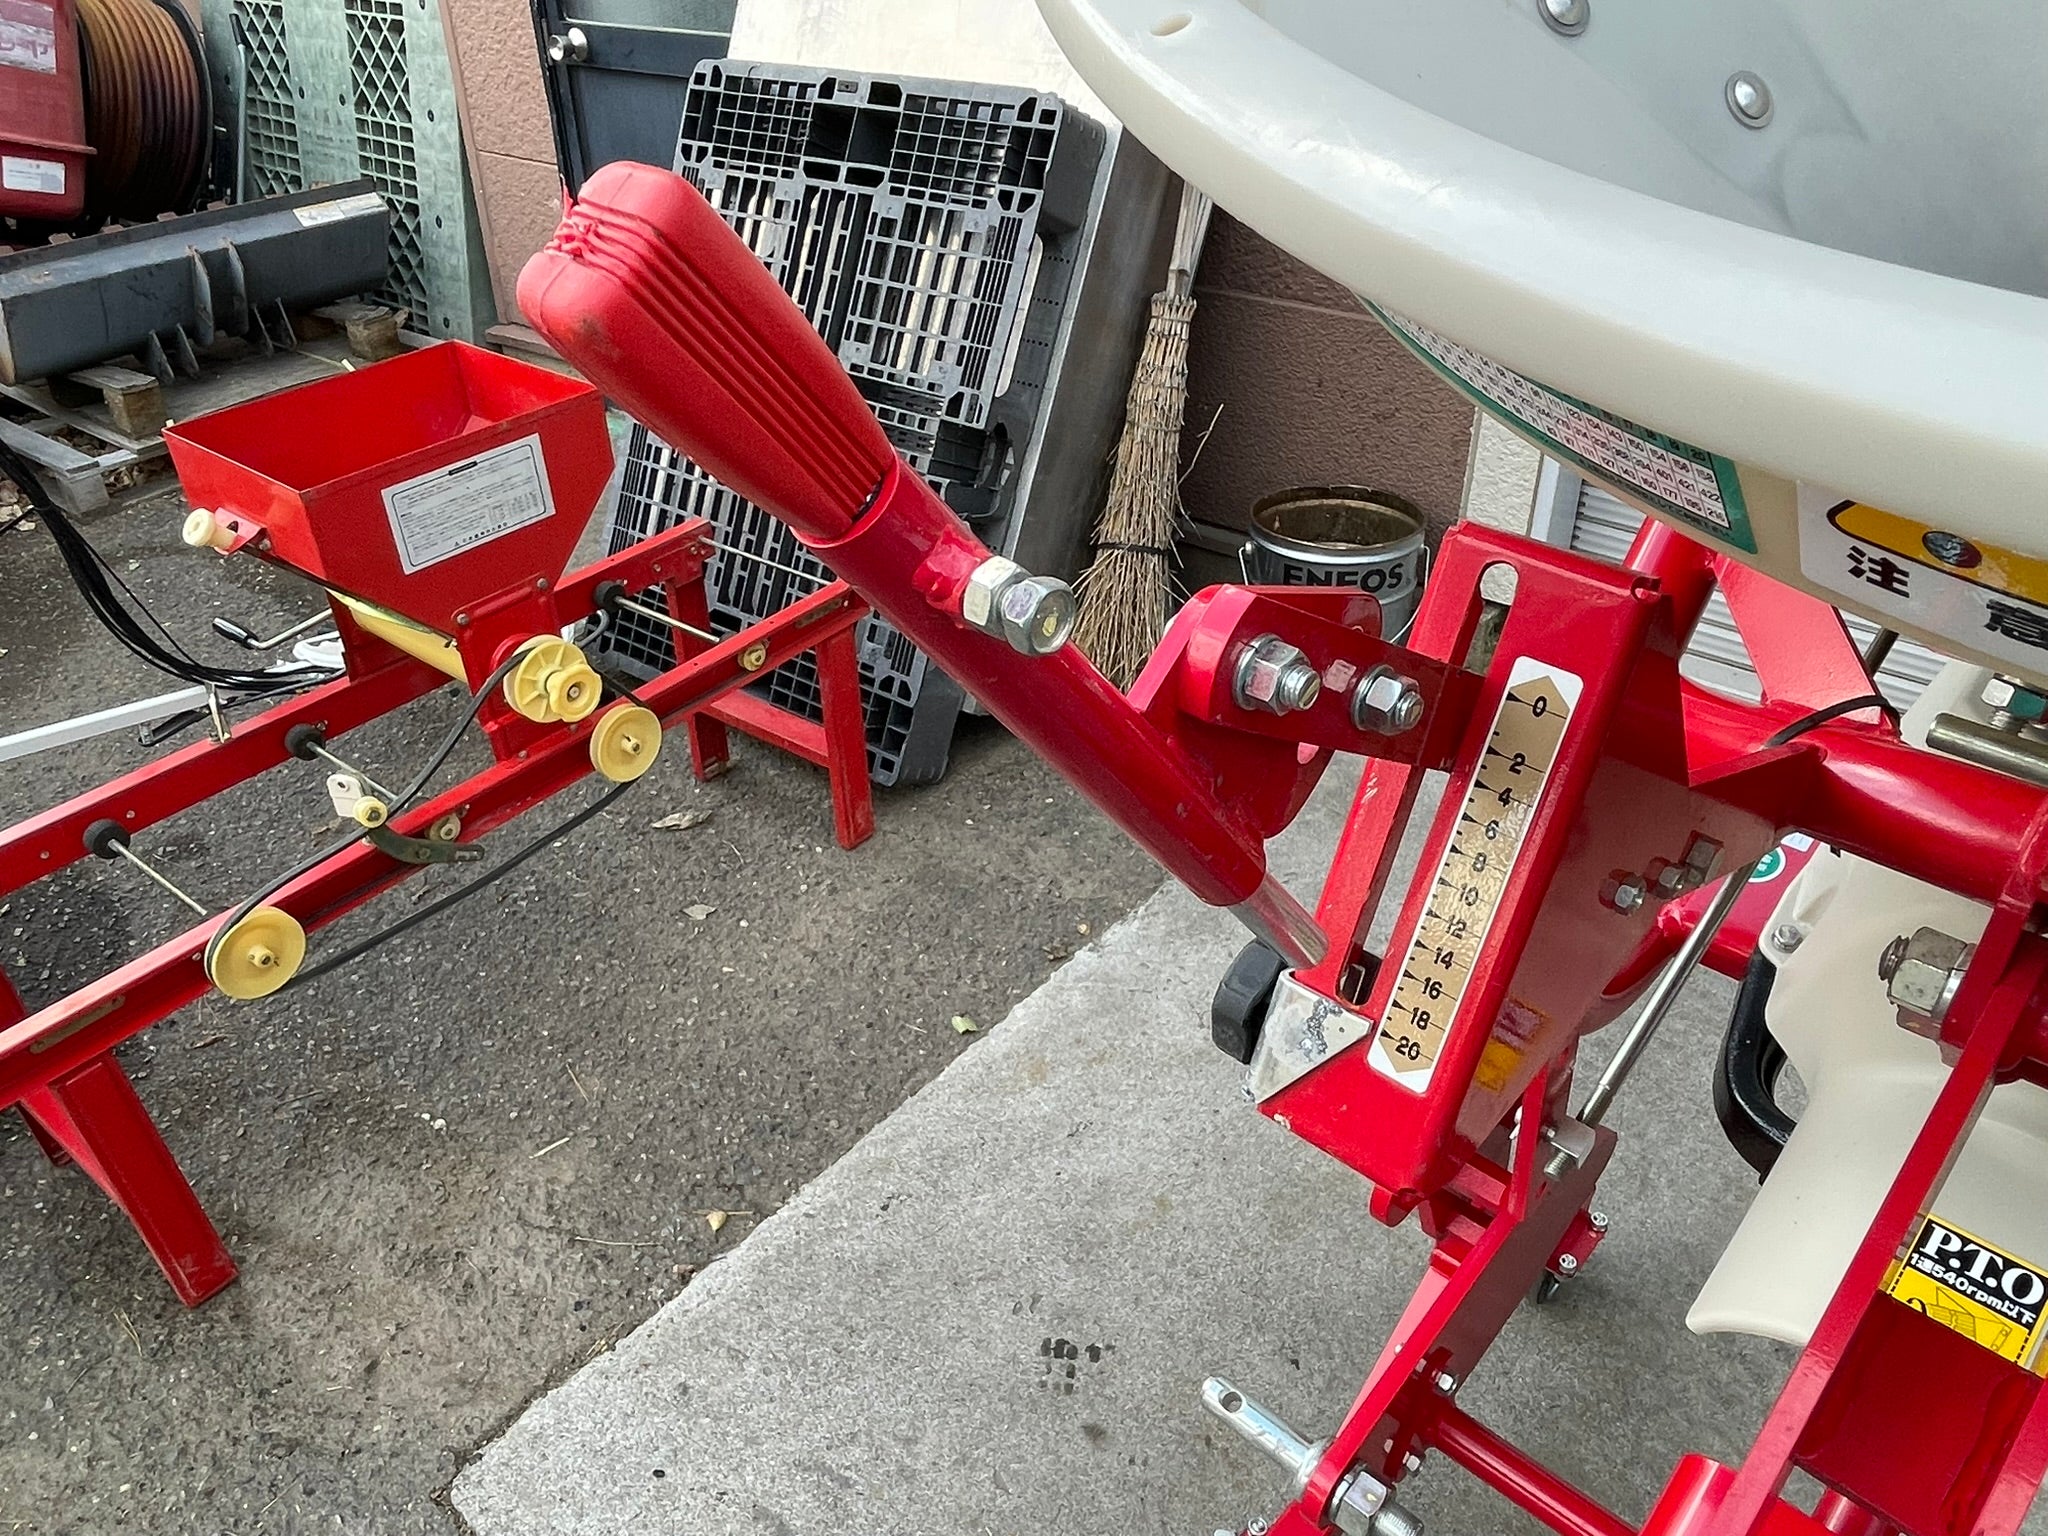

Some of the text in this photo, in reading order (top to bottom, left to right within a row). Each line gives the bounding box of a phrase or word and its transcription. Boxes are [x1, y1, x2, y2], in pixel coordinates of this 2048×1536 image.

[1283, 563, 1403, 592] ENEOS
[1532, 695, 1547, 717] 0
[1508, 752, 1526, 775] 2
[1497, 786, 1512, 807] 4
[1485, 819, 1499, 840] 6
[1472, 852, 1486, 872] 8
[1460, 882, 1479, 906] 10
[1447, 914, 1466, 938] 12
[1434, 943, 1453, 970] 14
[1423, 973, 1442, 999] 16
[1411, 1006, 1430, 1029] 18
[1396, 1035, 1420, 1060] 20
[1919, 1223, 2045, 1305] P.T.O
